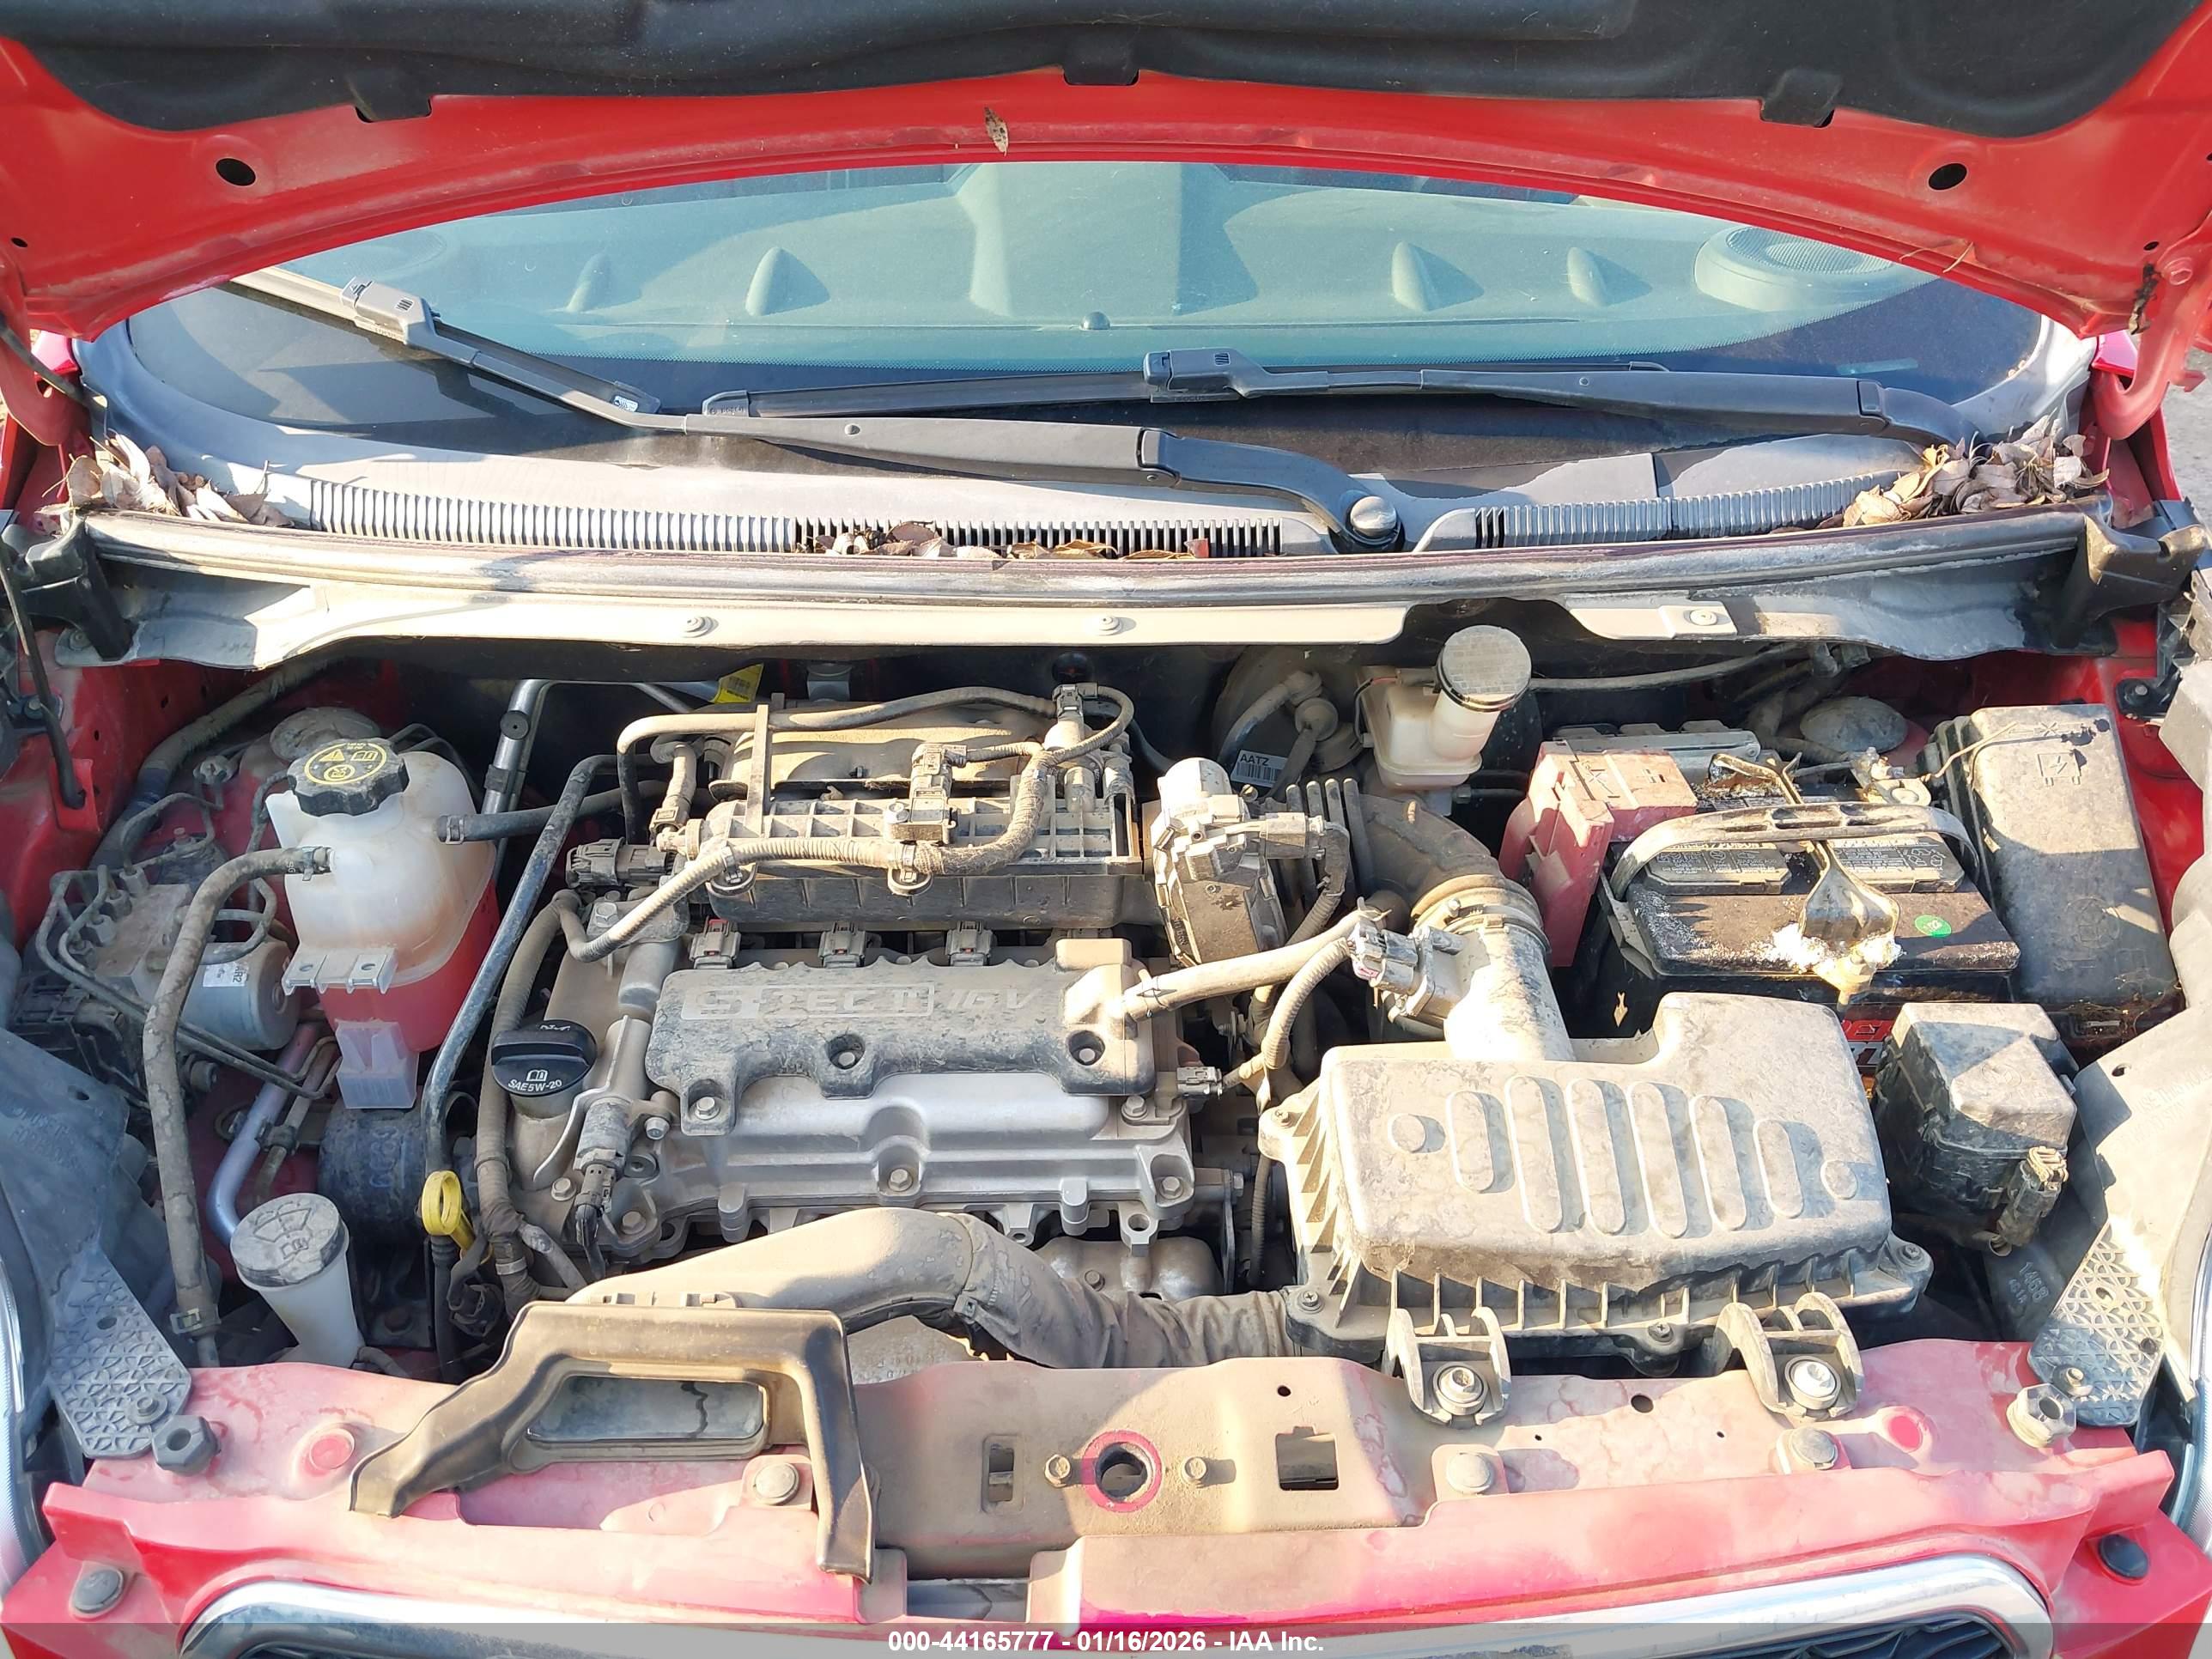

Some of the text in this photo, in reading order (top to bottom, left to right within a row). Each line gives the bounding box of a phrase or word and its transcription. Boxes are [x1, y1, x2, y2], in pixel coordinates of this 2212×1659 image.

[1240, 753, 1270, 767] AATZ
[946, 988, 1042, 1012] 16V
[507, 1079, 562, 1092] SAE5W-20
